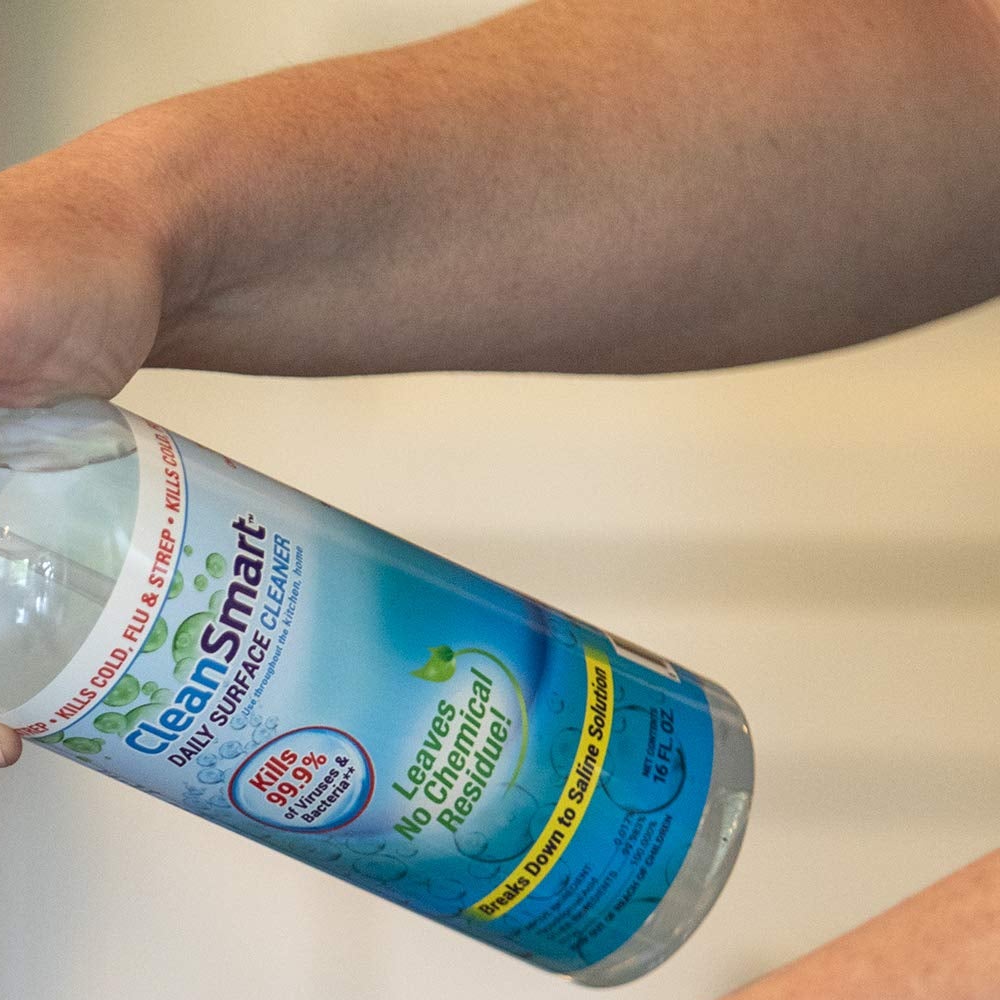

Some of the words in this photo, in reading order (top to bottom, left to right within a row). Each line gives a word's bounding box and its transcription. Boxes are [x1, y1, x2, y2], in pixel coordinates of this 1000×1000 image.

[164, 468, 181, 513] KILLS
[149, 528, 176, 588] STREP
[123, 608, 150, 642] FLU
[141, 592, 159, 607] &
[125, 516, 266, 755] CleanSmart
[167, 724, 215, 767] DAILY
[209, 629, 272, 727] SURFACE
[260, 533, 291, 630] CLEANER
[241, 698, 258, 717] Use
[254, 644, 283, 697] throughout
[279, 627, 289, 645] the
[292, 545, 304, 576] home
[90, 647, 134, 689] COLD,
[55, 688, 97, 720] KILLS
[248, 749, 298, 792] Kills
[266, 751, 328, 807] 99.9%
[391, 699, 456, 801] Leaves
[392, 806, 432, 842] No
[423, 666, 494, 805] Chemical
[436, 706, 512, 834] Residue!
[653, 763, 669, 784] 16
[284, 807, 300, 820] of
[294, 768, 340, 810] Viruses
[335, 755, 350, 768] &
[478, 875, 530, 917] Breaks
[524, 828, 565, 877] Down
[557, 807, 577, 828] to
[568, 745, 600, 804] Saline
[588, 666, 608, 741] Solution
